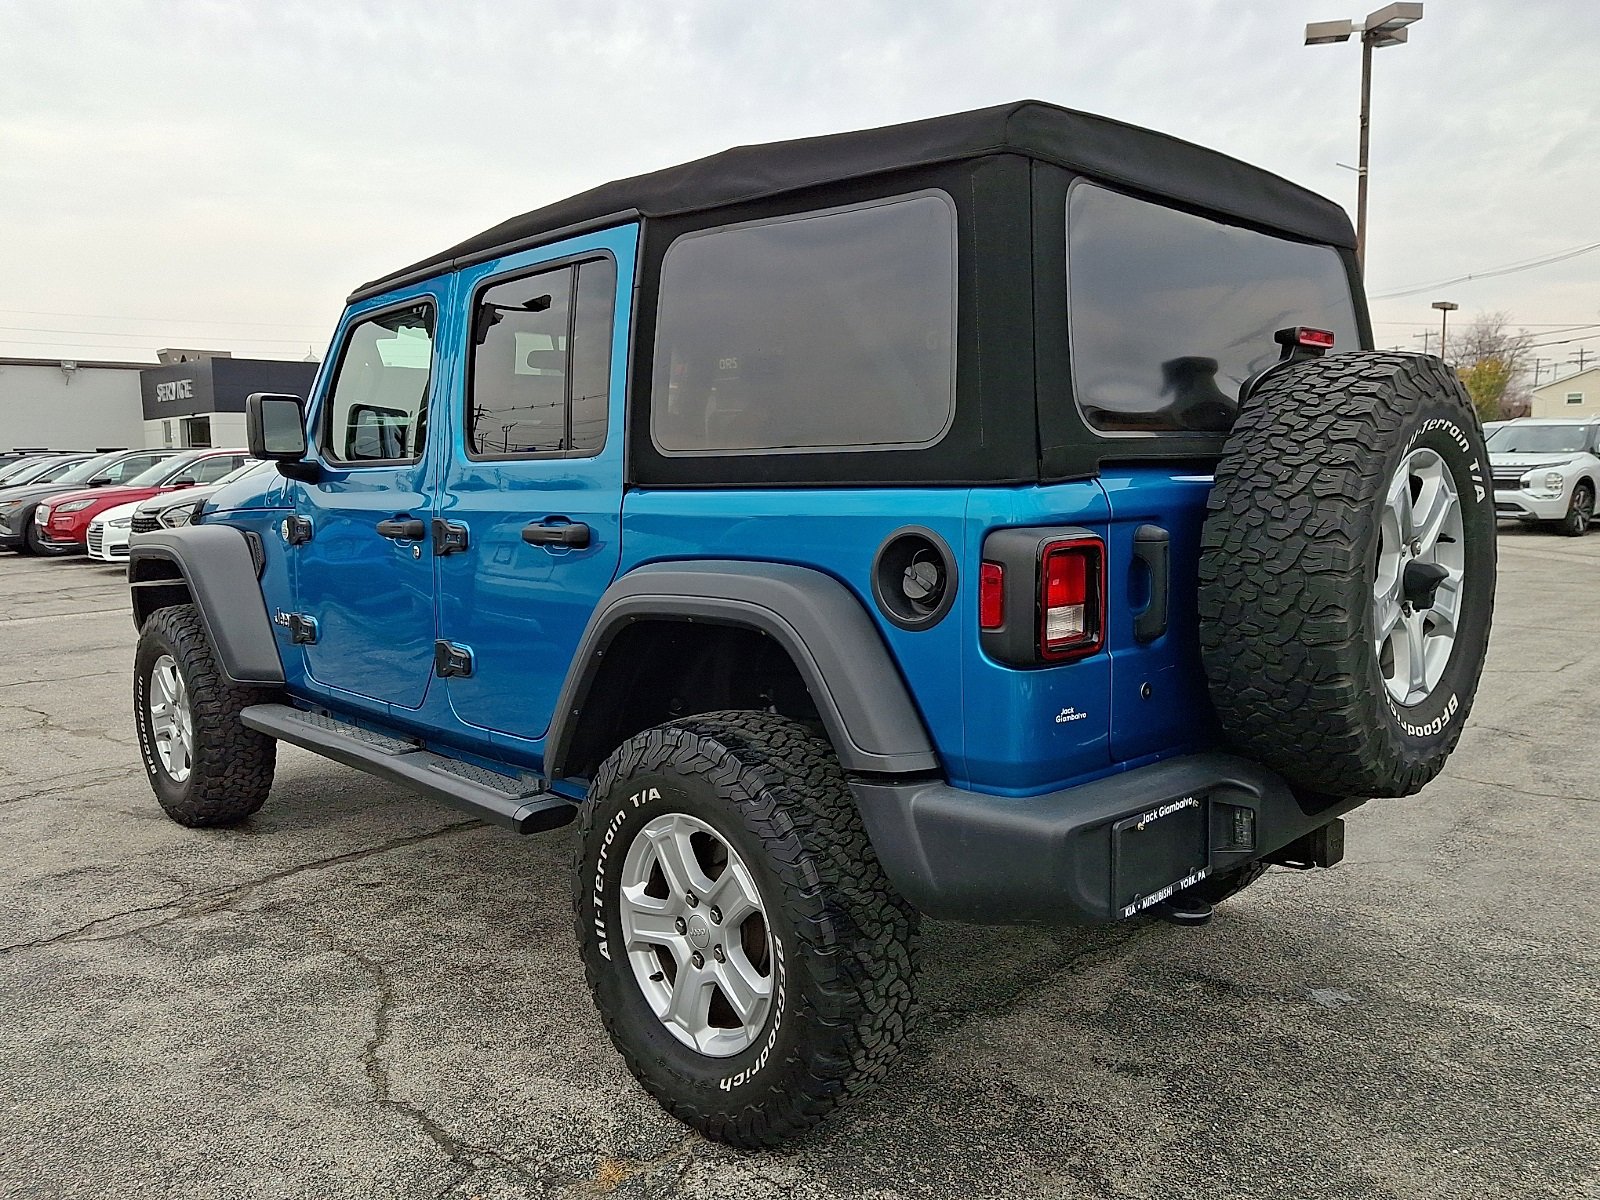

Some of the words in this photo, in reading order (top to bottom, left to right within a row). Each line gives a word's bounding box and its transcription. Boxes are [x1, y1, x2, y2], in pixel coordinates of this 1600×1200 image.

[157, 379, 193, 402] SERVICE
[1469, 458, 1486, 503] T/A
[274, 607, 291, 627] Jee
[138, 676, 158, 775] BFGoodrich
[1056, 712, 1087, 723] Giambalvo
[1061, 707, 1075, 715] Jack
[1142, 810, 1158, 824] Jack
[1159, 797, 1193, 816] Giambalvo
[593, 809, 627, 961] All-Terrain
[630, 787, 662, 807] T/A
[1125, 906, 1136, 918] KIA
[1142, 886, 1173, 909] MITSUBISHI
[1198, 870, 1206, 881] PA
[719, 935, 787, 1092] BFGoodrich
